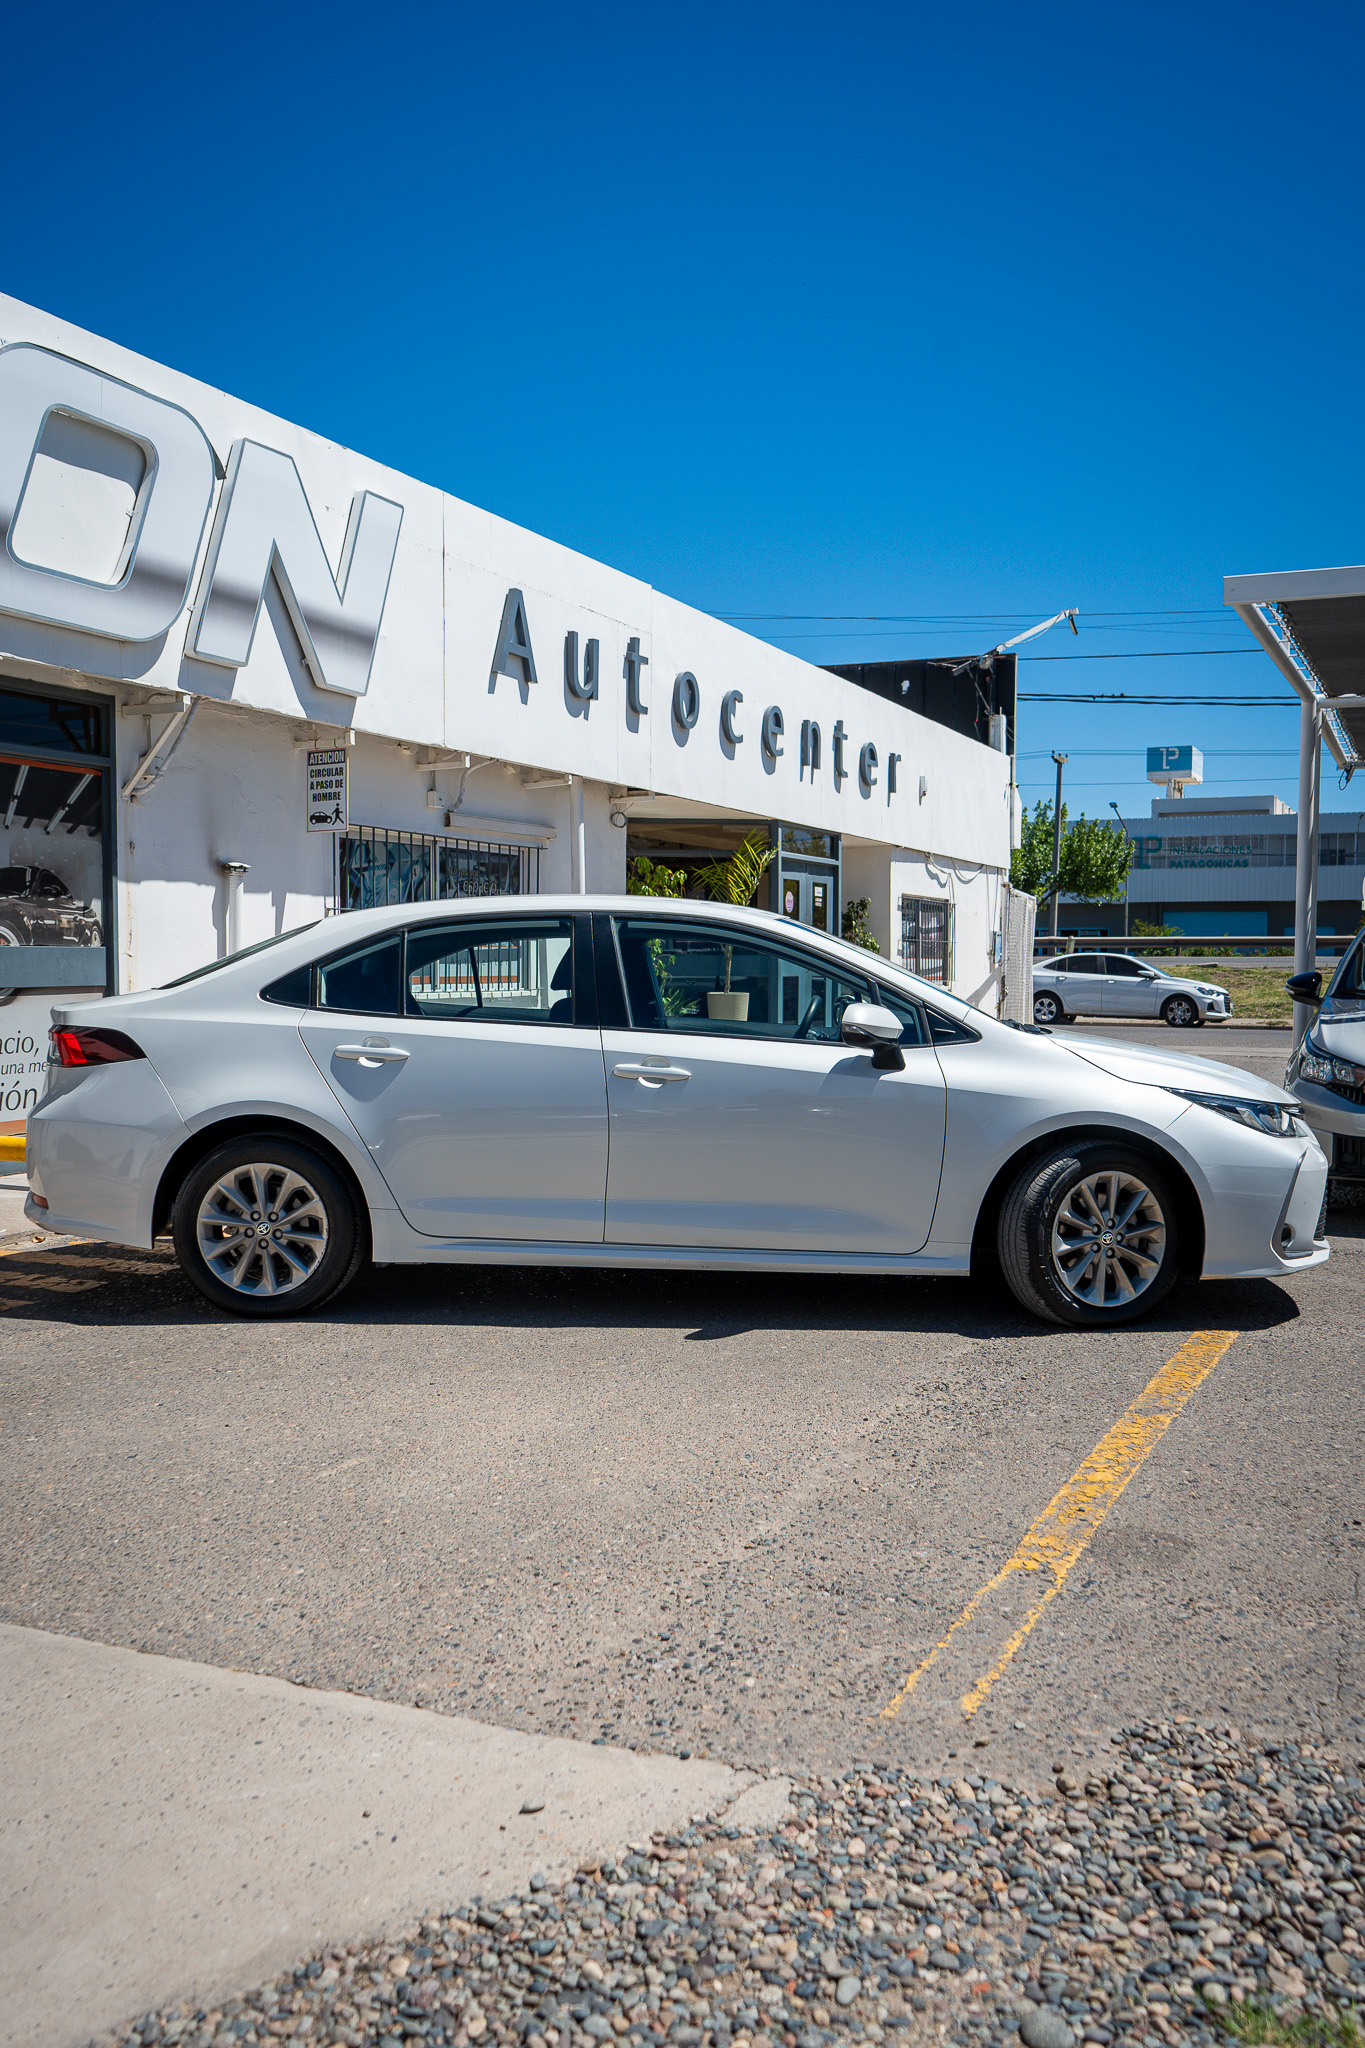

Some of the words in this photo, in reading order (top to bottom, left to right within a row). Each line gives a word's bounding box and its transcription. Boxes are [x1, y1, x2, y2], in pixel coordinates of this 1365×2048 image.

[489, 587, 903, 796] Autocenter
[309, 750, 345, 765] ATENCION
[309, 766, 344, 779] CIRCULAR
[309, 781, 315, 791] A
[315, 780, 334, 790] PASO
[335, 779, 344, 789] DE
[312, 791, 342, 803] HOMBRE
[1169, 846, 1253, 856] INSTALACIONES
[1169, 859, 1250, 869] PATAGONICAS
[1, 1063, 24, 1076] una
